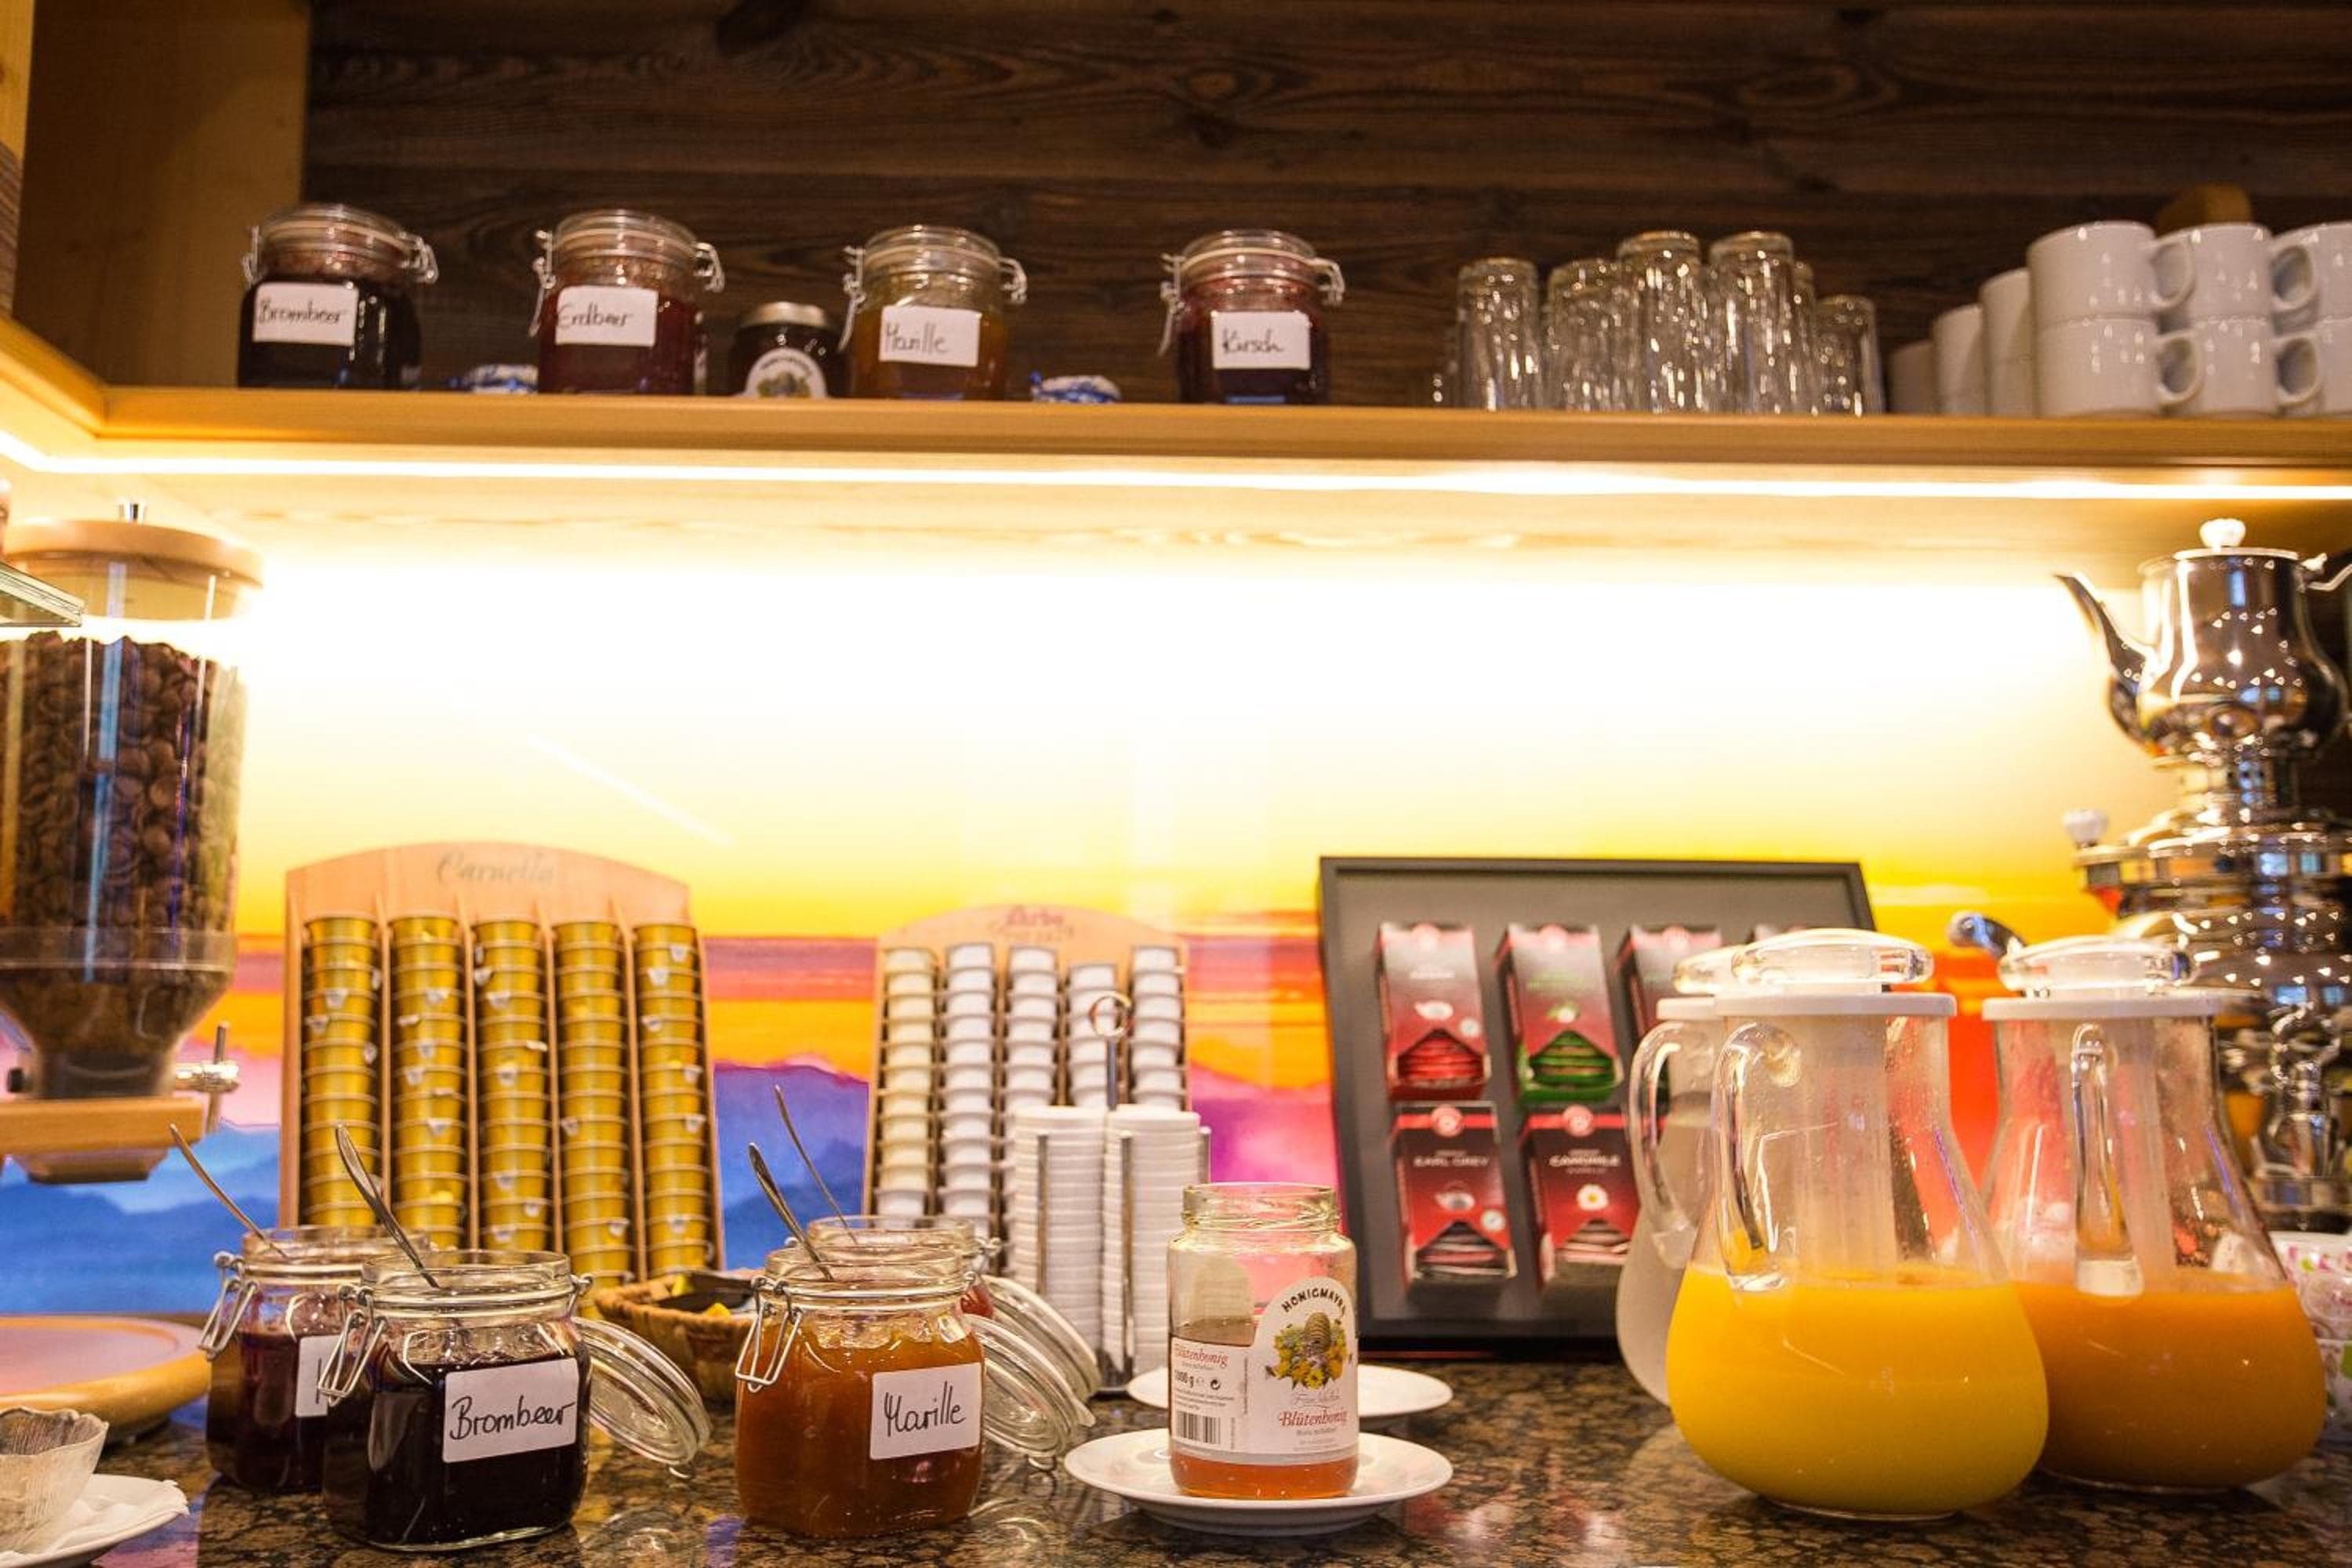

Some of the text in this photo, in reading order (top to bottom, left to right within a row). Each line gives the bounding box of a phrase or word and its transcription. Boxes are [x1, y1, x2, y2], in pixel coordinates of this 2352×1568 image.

[259, 296, 348, 325] Brombeer
[557, 301, 633, 330] Erdbeer
[885, 321, 951, 354] Marille
[1222, 328, 1285, 354] Kirsch
[450, 1395, 577, 1440] Brombeer
[884, 1381, 967, 1437] Marille
